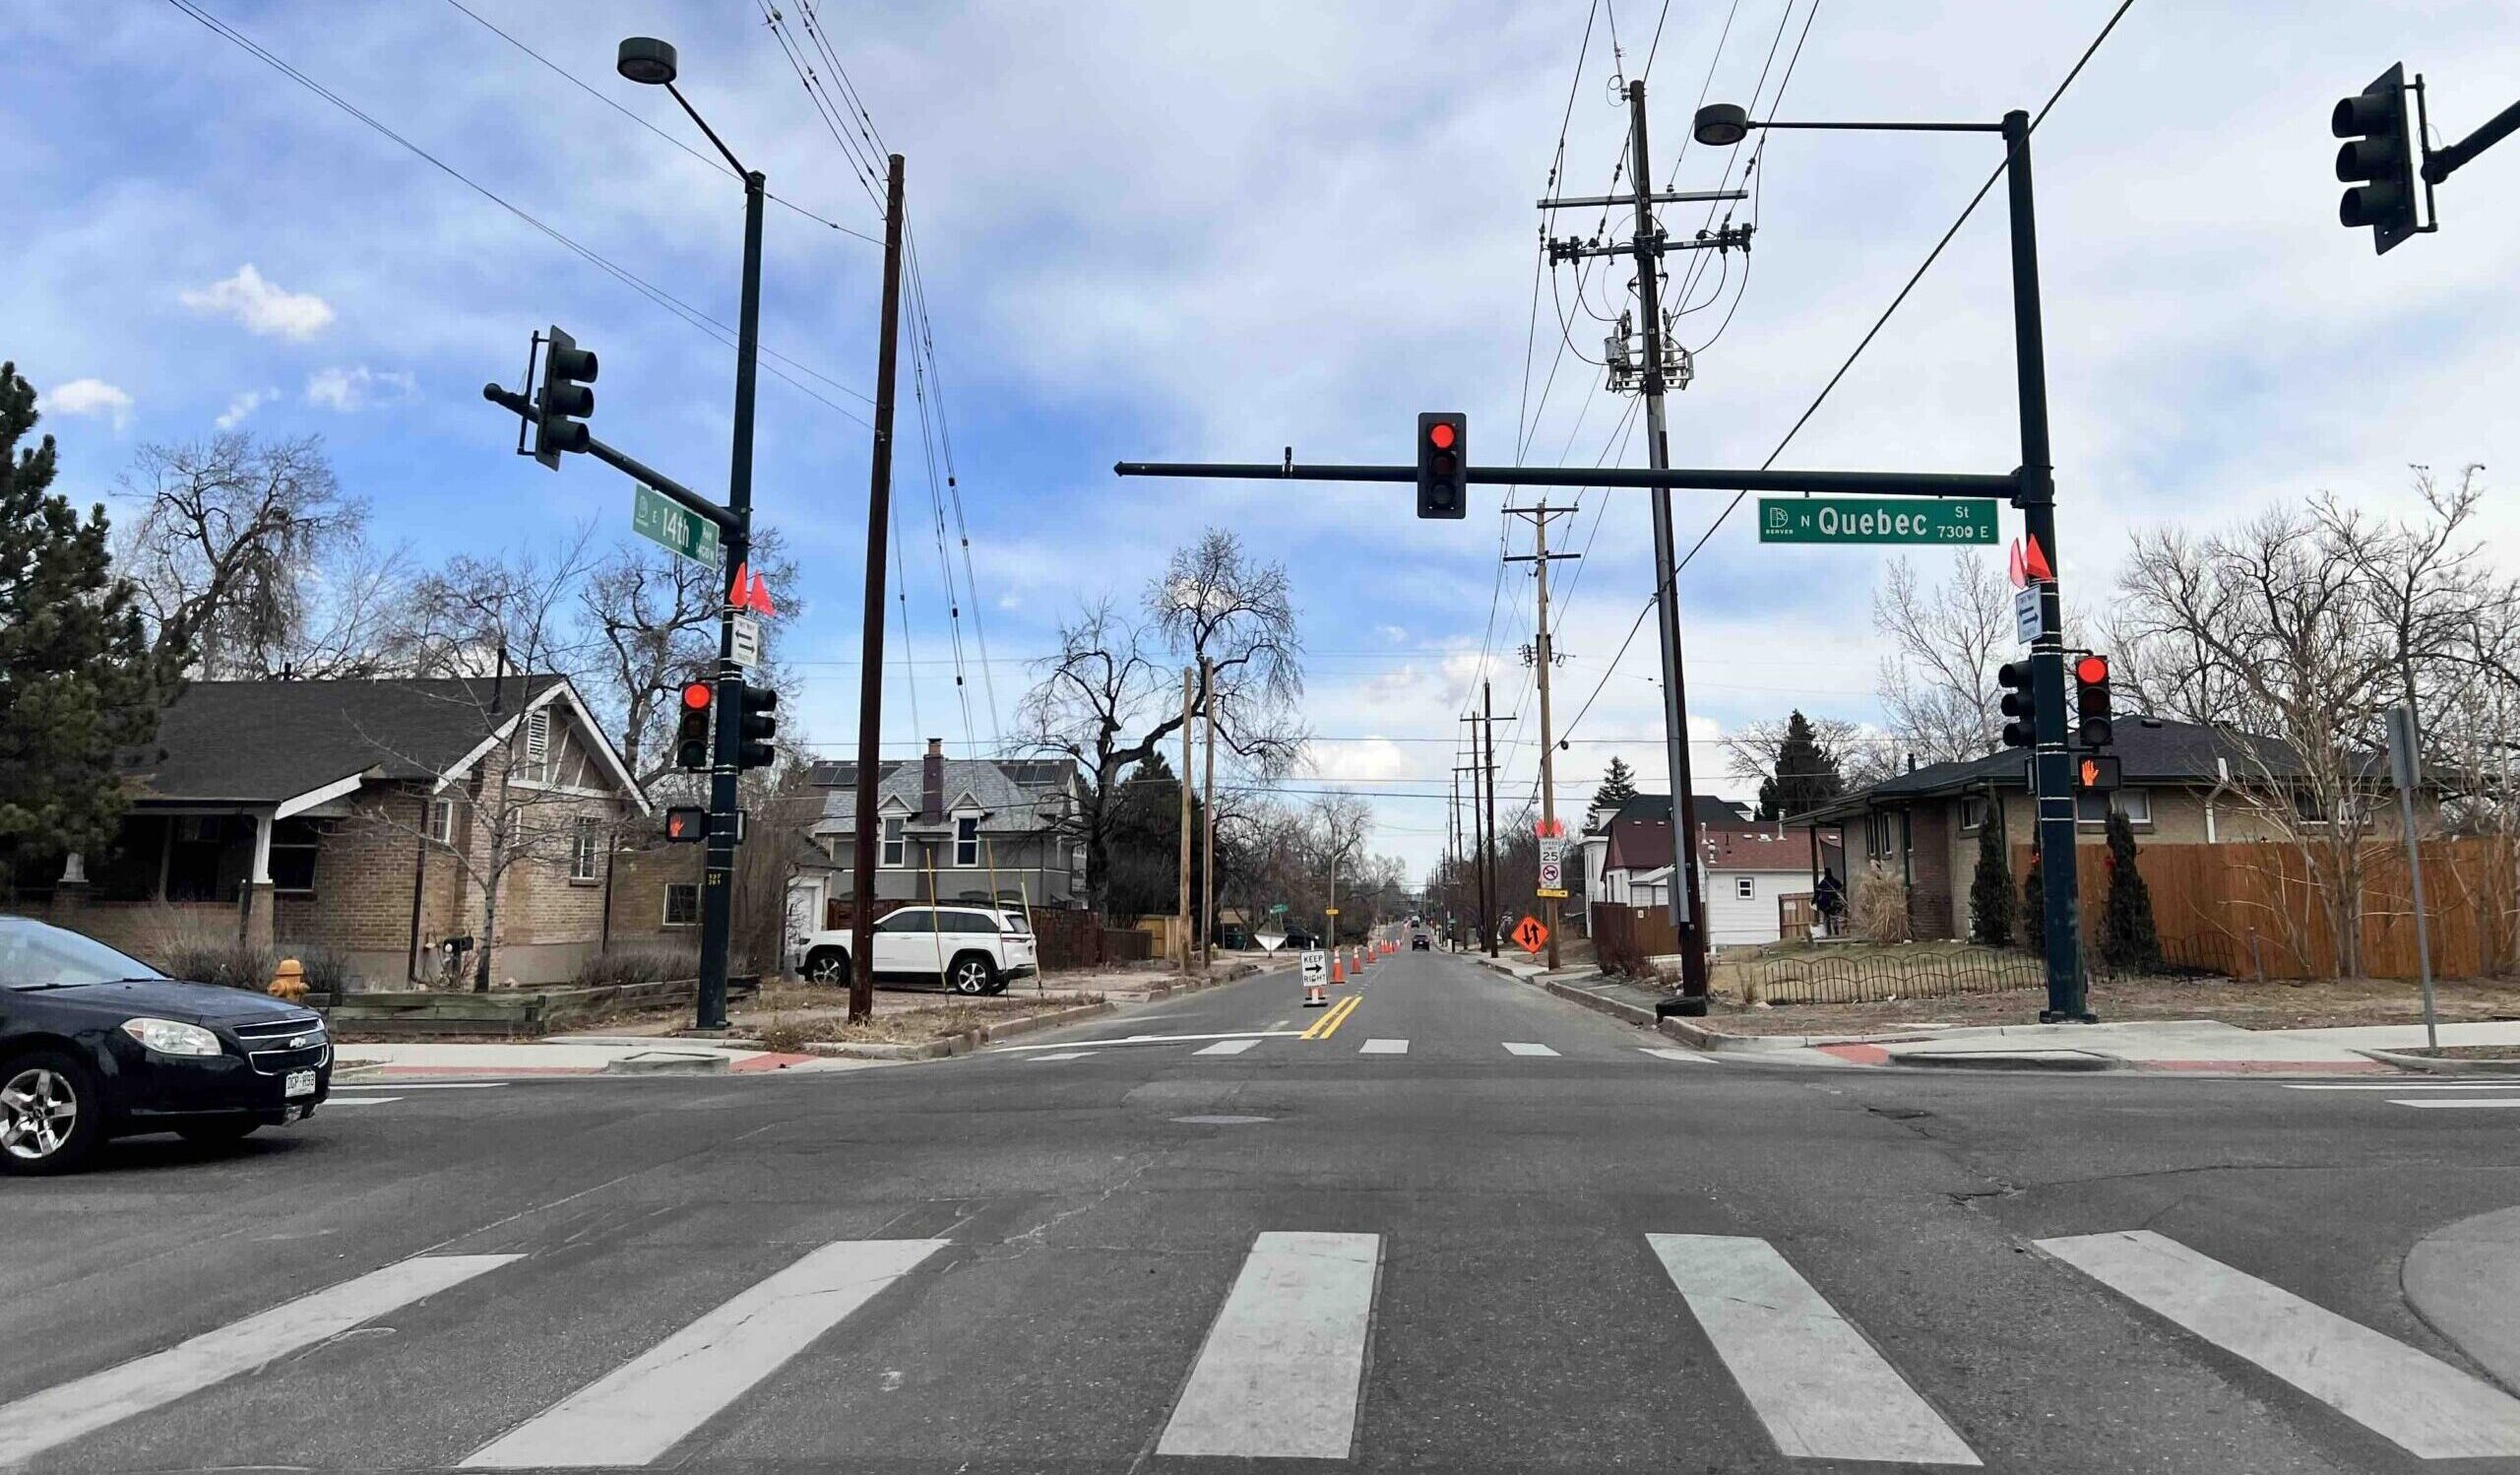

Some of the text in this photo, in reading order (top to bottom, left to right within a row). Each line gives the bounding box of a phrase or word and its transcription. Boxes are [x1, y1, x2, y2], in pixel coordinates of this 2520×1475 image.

[652, 510, 658, 524] E
[662, 507, 689, 548] 14th
[1800, 505, 1970, 536] N Quebec St
[1936, 525, 1989, 539] 7300 E
[1543, 852, 1559, 862] 25
[1303, 974, 1326, 983] RIGHT
